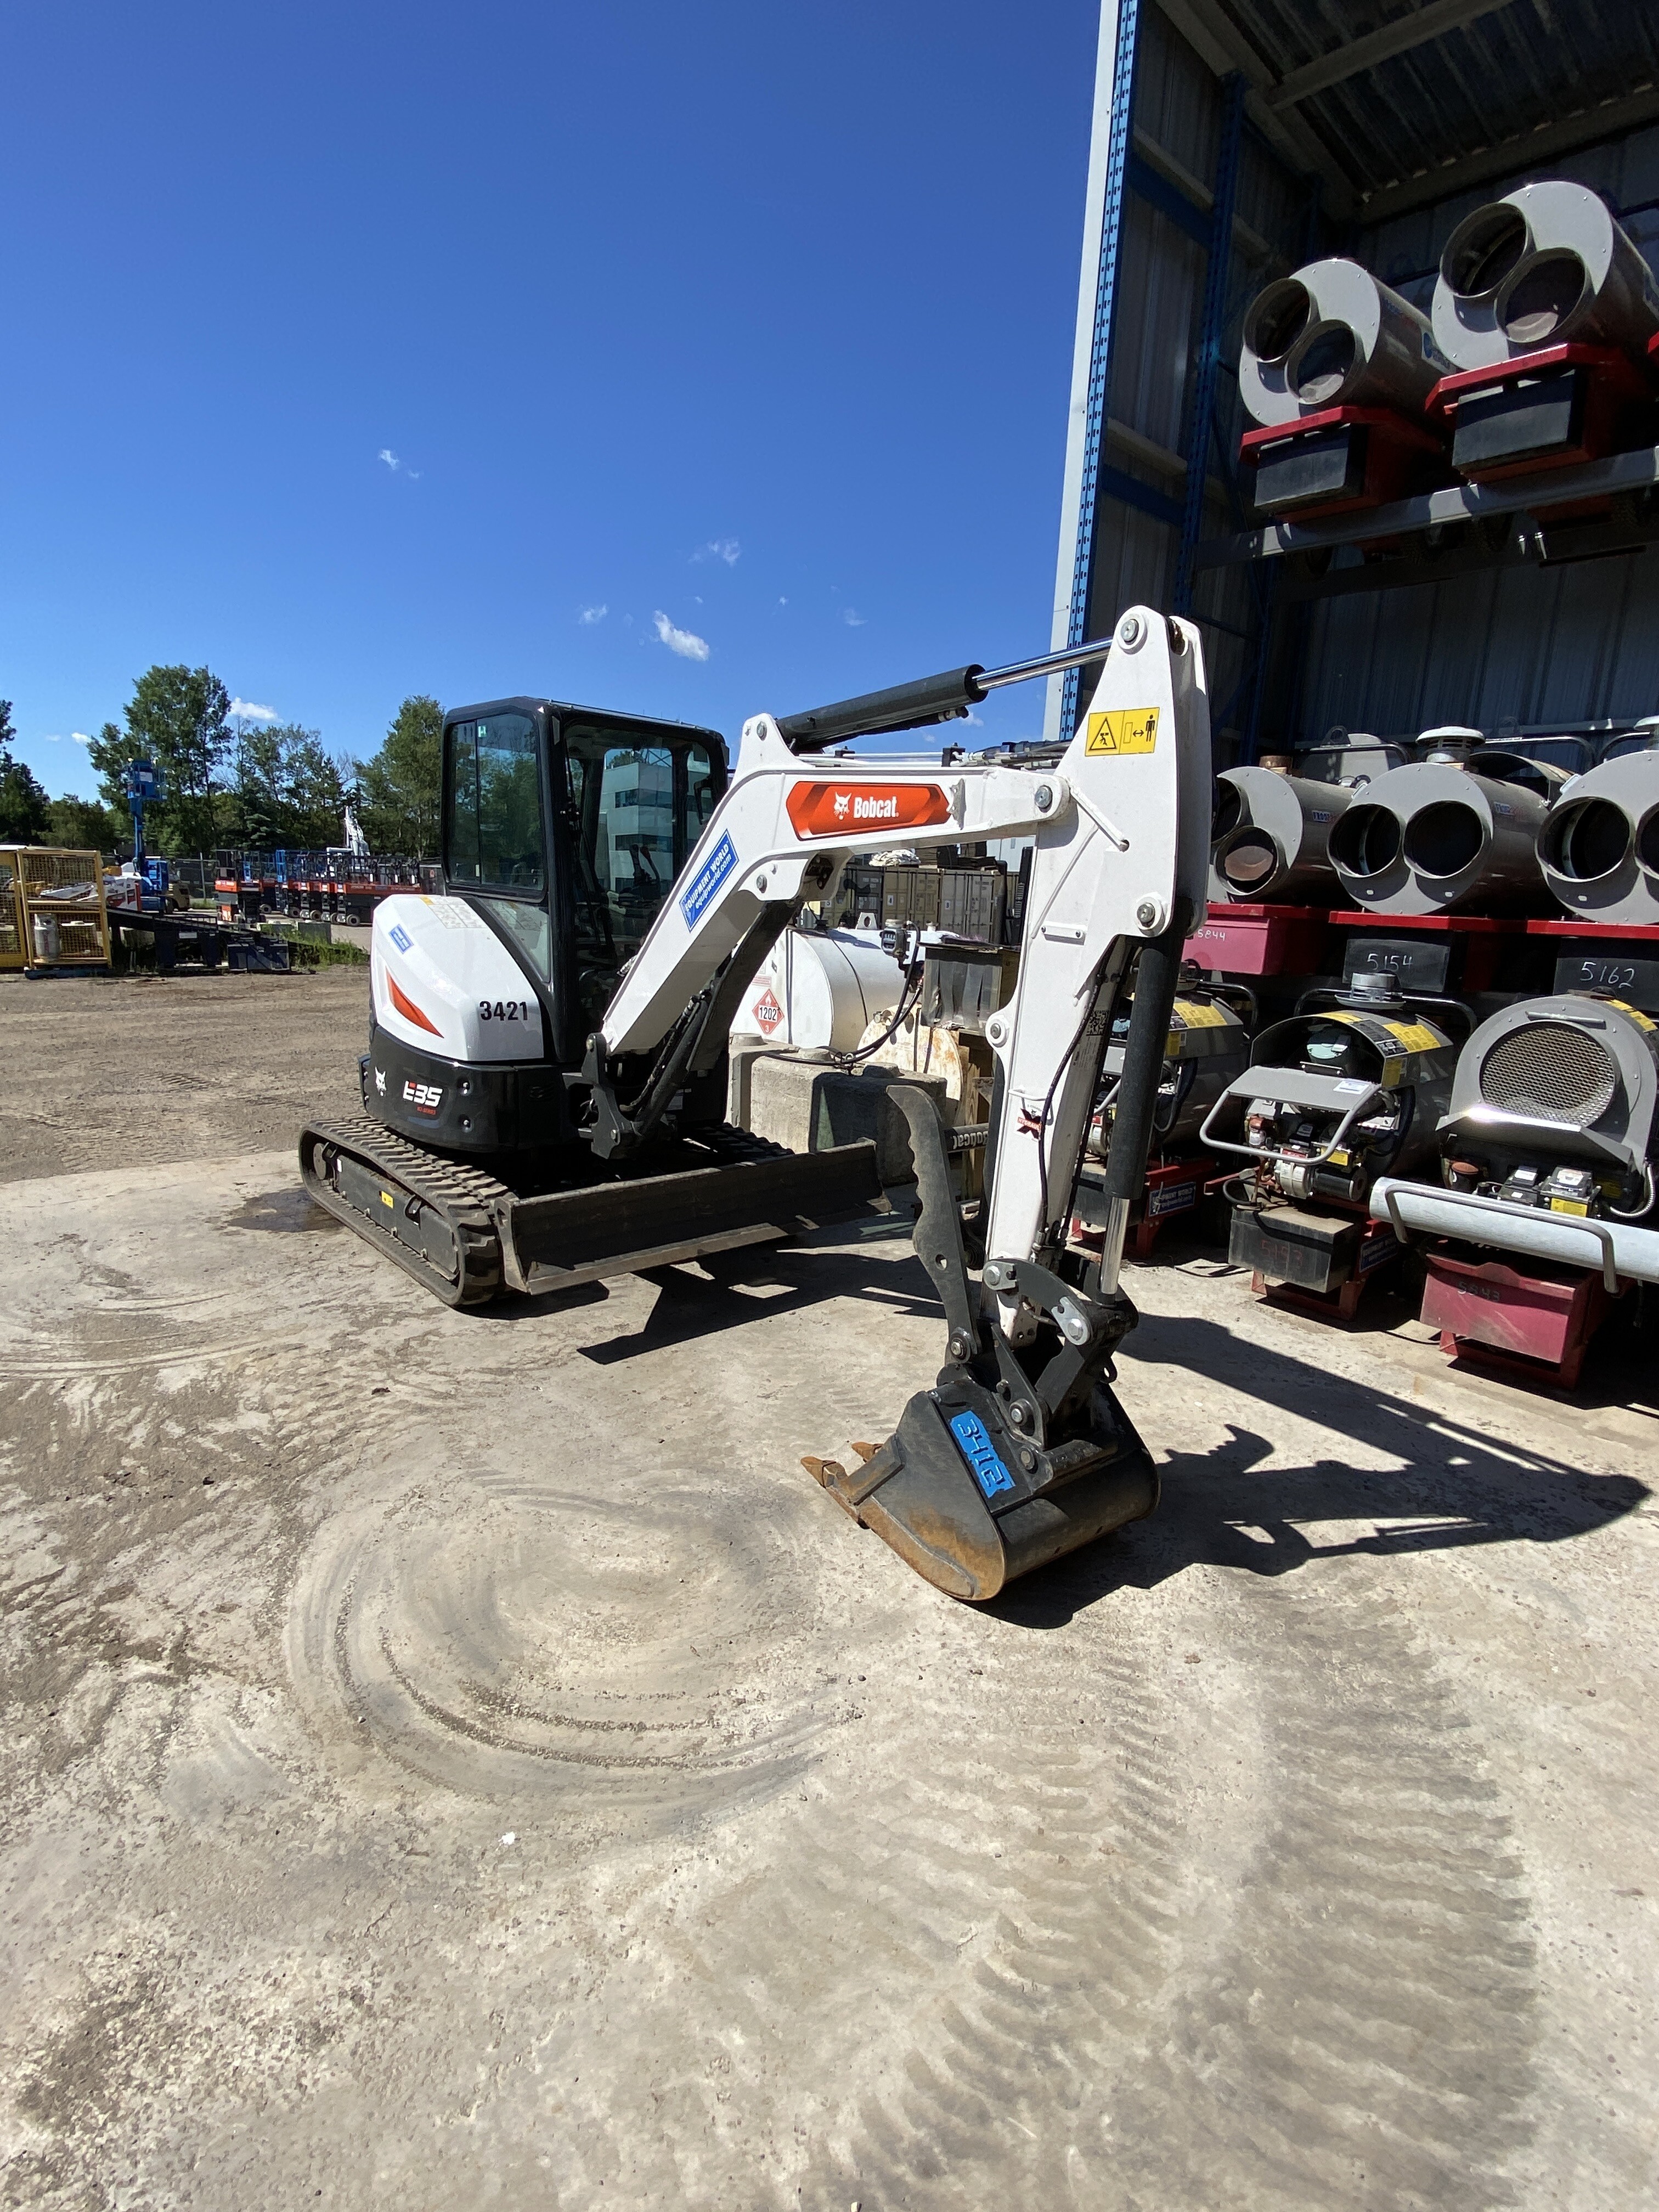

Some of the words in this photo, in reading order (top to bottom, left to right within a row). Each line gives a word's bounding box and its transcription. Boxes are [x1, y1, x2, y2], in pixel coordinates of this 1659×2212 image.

[854, 796, 897, 819] Bobcat
[685, 870, 711, 912] EQUIPMENT
[710, 843, 729, 873] WORLD
[695, 853, 732, 909] equipworld.com
[1197, 928, 1226, 941] 5844
[1367, 953, 1414, 972] 5154
[1580, 961, 1634, 988] 5162
[479, 1001, 528, 1021] 3421
[759, 1006, 777, 1021] 1202
[403, 1080, 443, 1107] E35
[957, 1418, 1007, 1488] 3412
